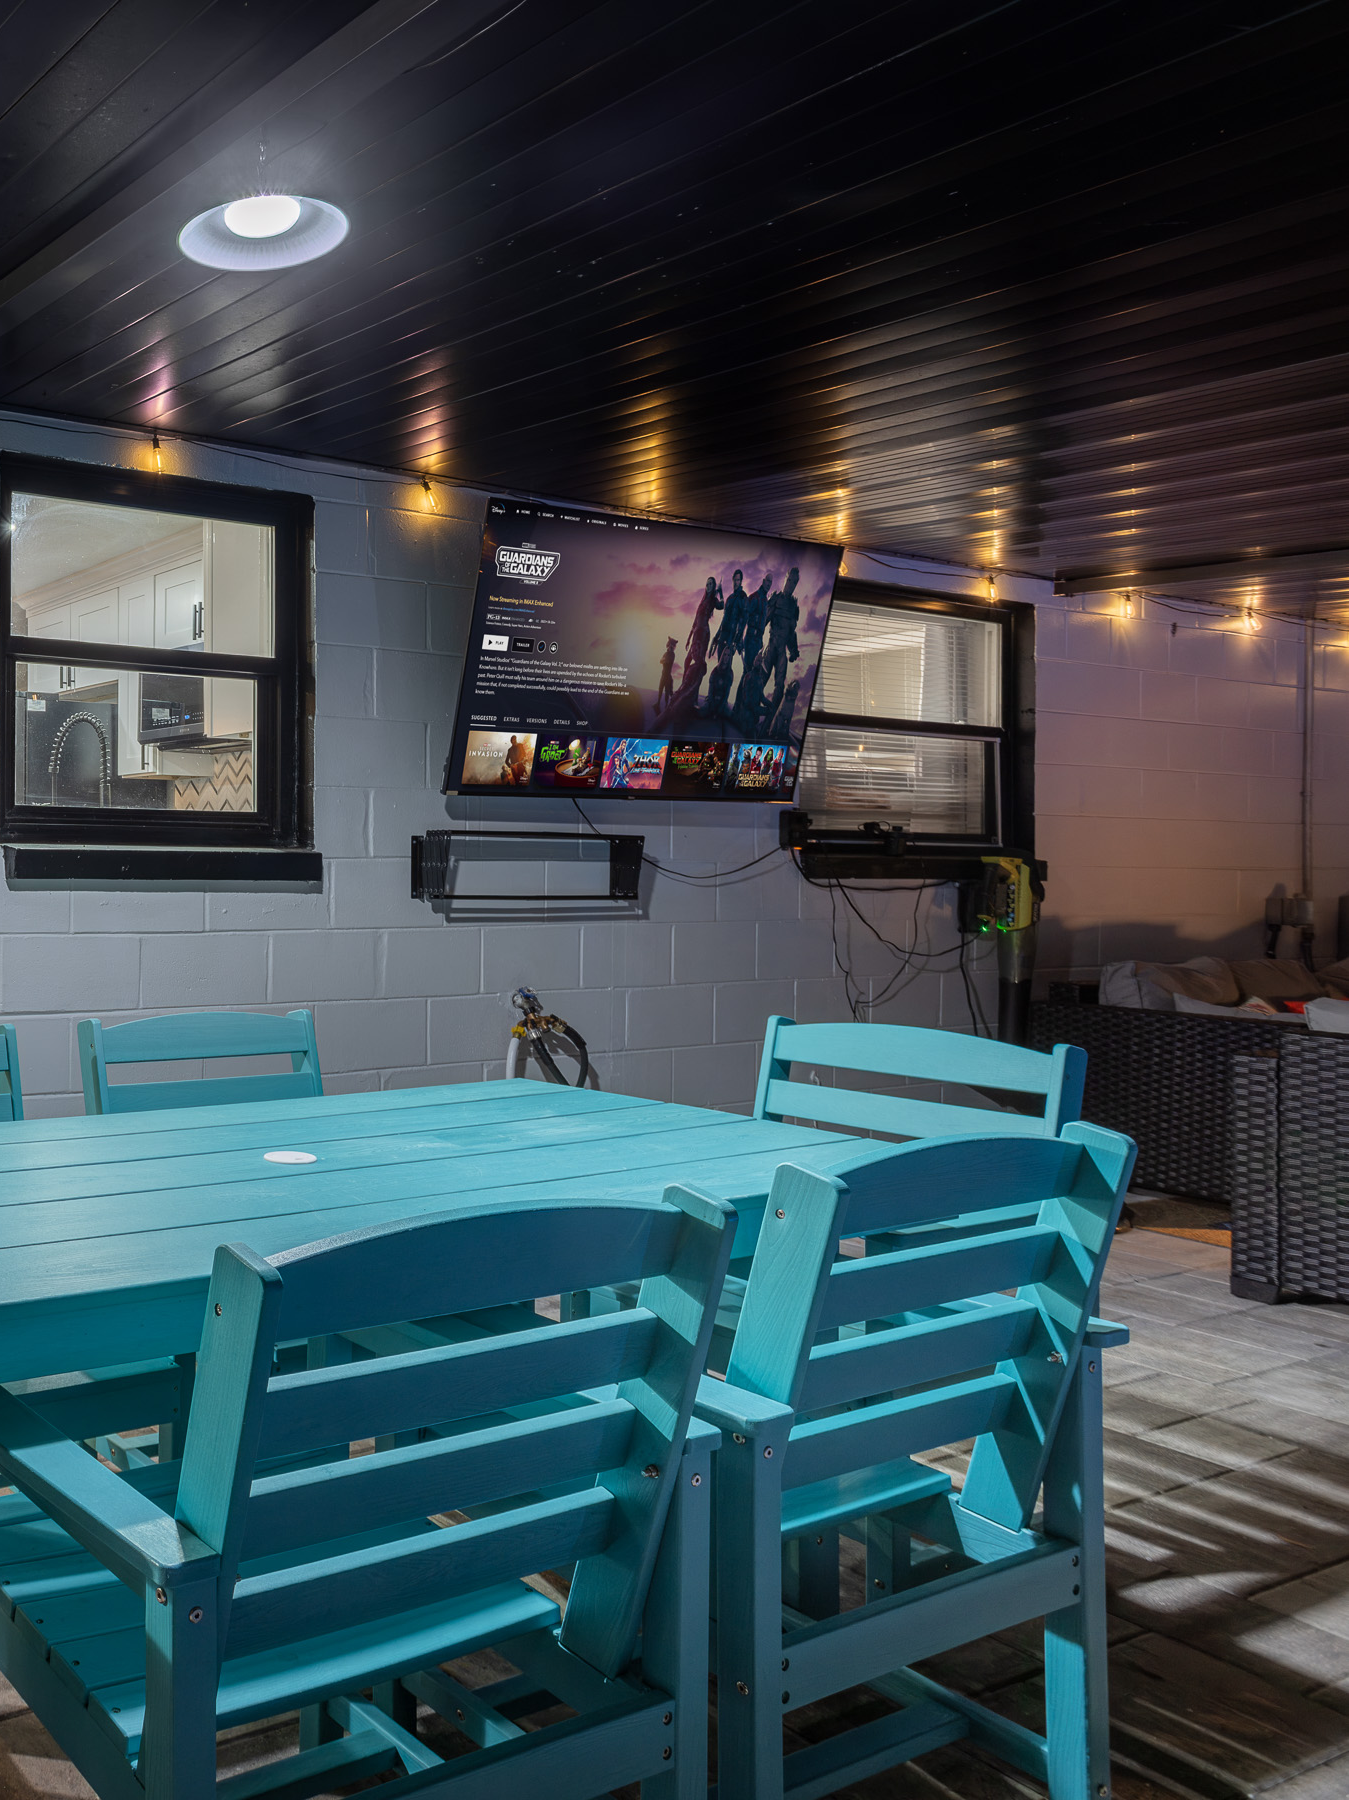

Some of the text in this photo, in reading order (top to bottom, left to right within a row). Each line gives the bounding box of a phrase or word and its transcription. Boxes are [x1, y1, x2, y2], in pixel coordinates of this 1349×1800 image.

[499, 551, 554, 567] GUARDIANS
[510, 563, 550, 576] GALAXY
[499, 596, 519, 605] Streaming
[634, 755, 661, 763] THOR
